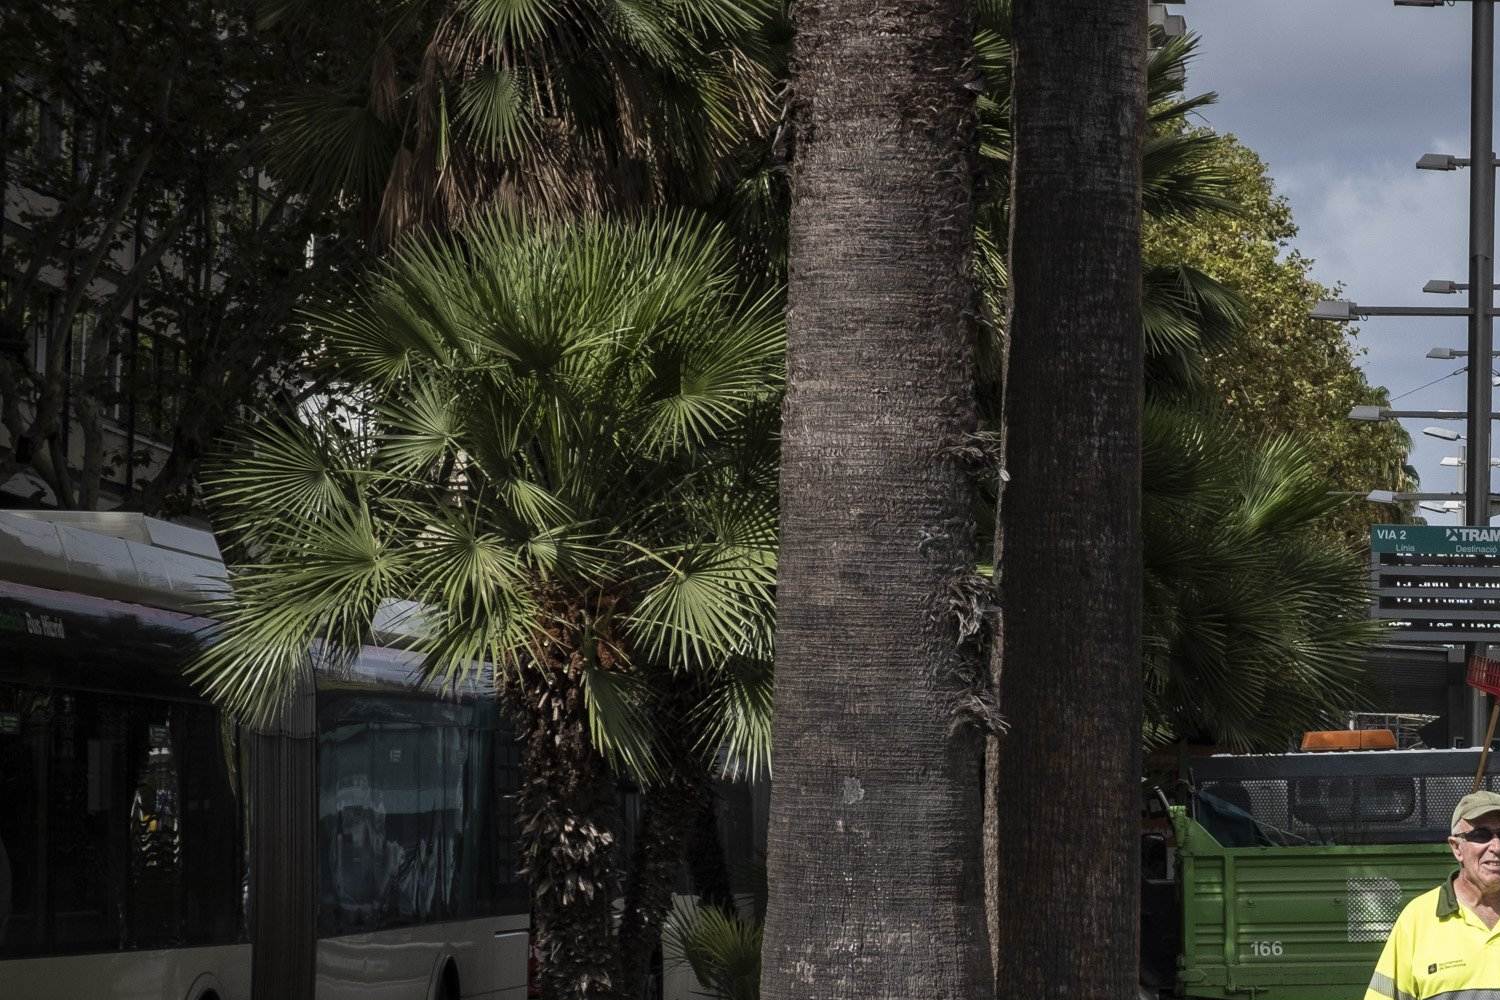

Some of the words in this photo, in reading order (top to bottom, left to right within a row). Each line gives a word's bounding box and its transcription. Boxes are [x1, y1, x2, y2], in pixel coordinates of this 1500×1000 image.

[1377, 529, 1396, 540] VIA
[1399, 529, 1407, 540] 2
[1455, 543, 1497, 553] Destinació
[1250, 940, 1283, 957] 166
